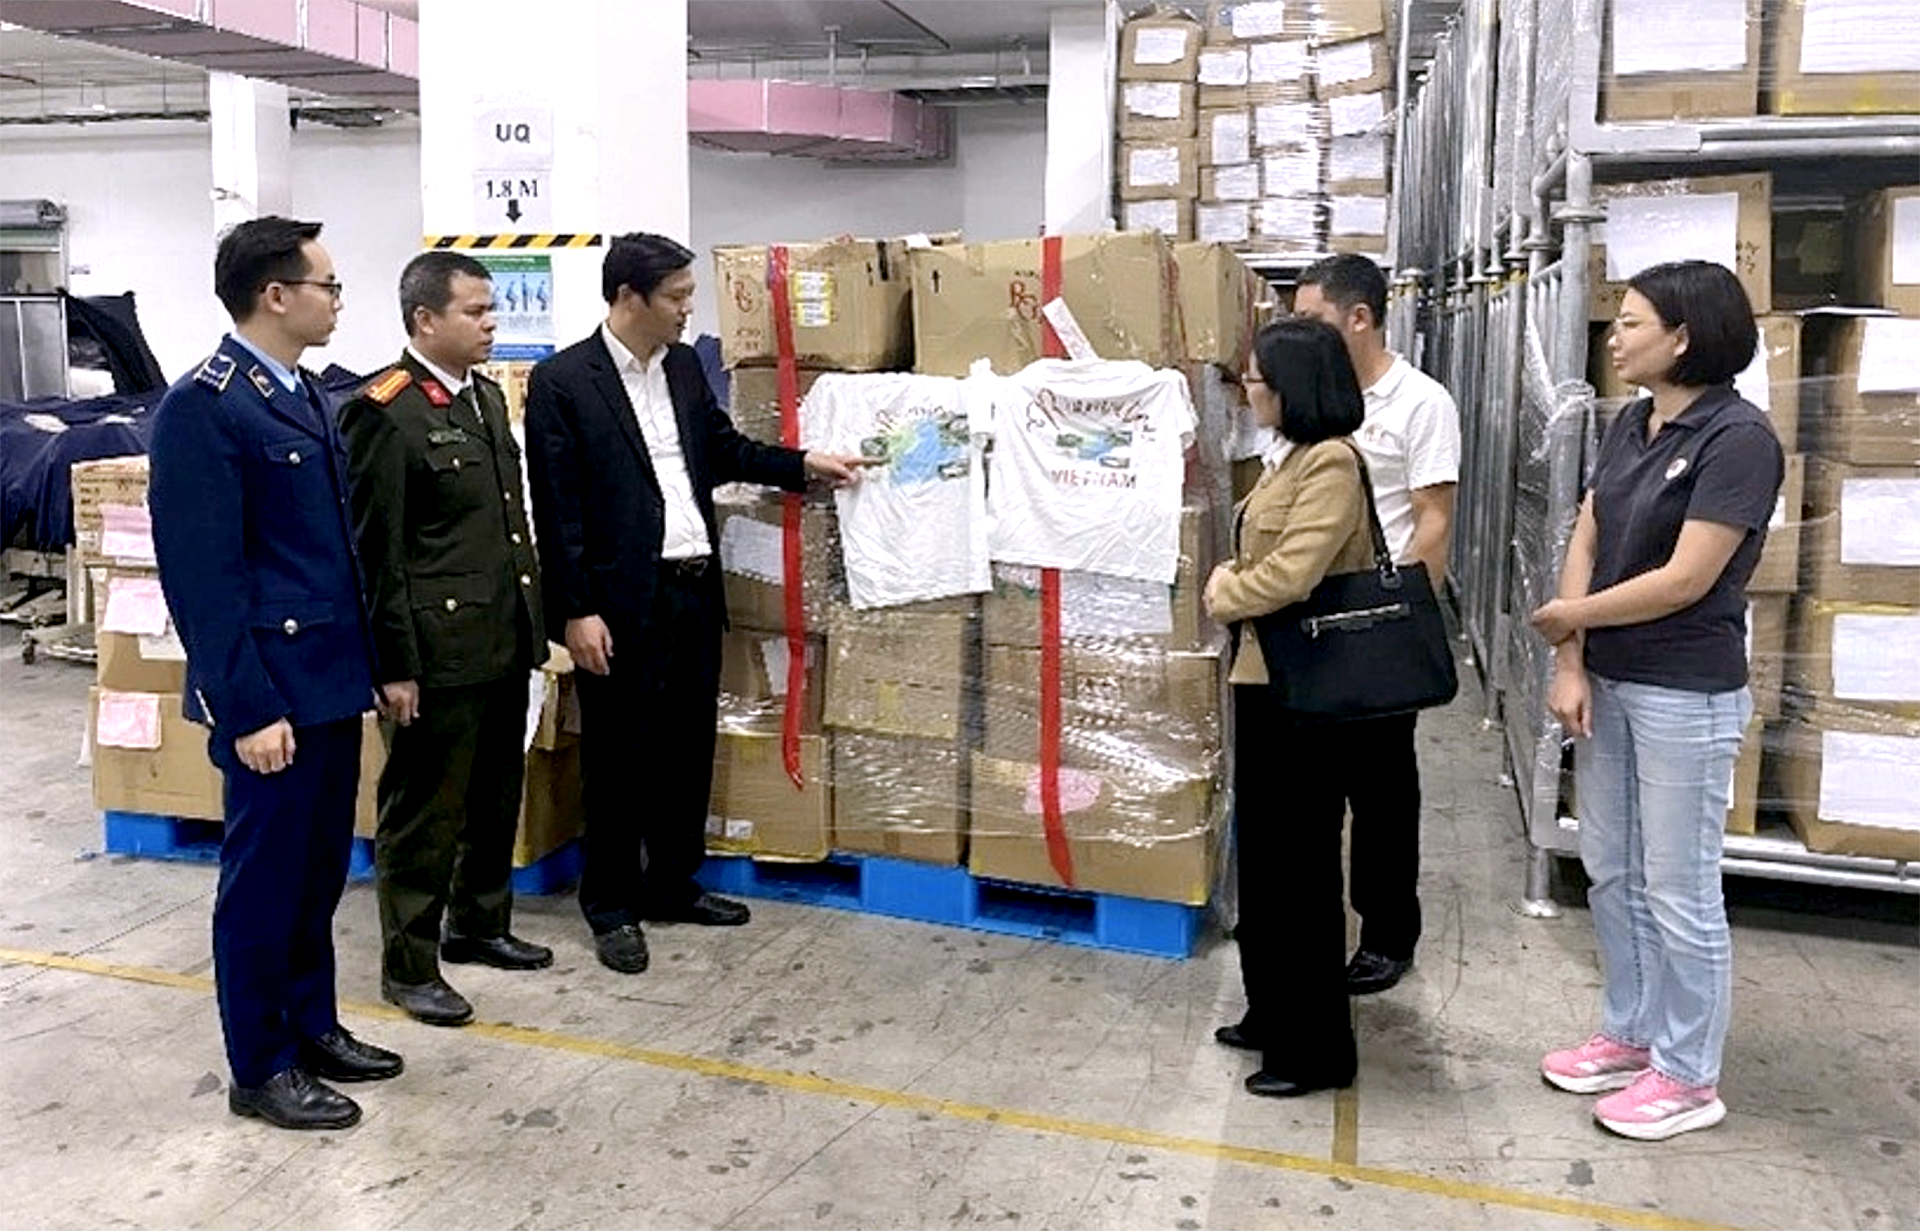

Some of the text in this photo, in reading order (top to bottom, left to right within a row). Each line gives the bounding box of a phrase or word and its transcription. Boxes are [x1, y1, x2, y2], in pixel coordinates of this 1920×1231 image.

[496, 123, 531, 144] UQ
[486, 179, 539, 200] 1.8 M
